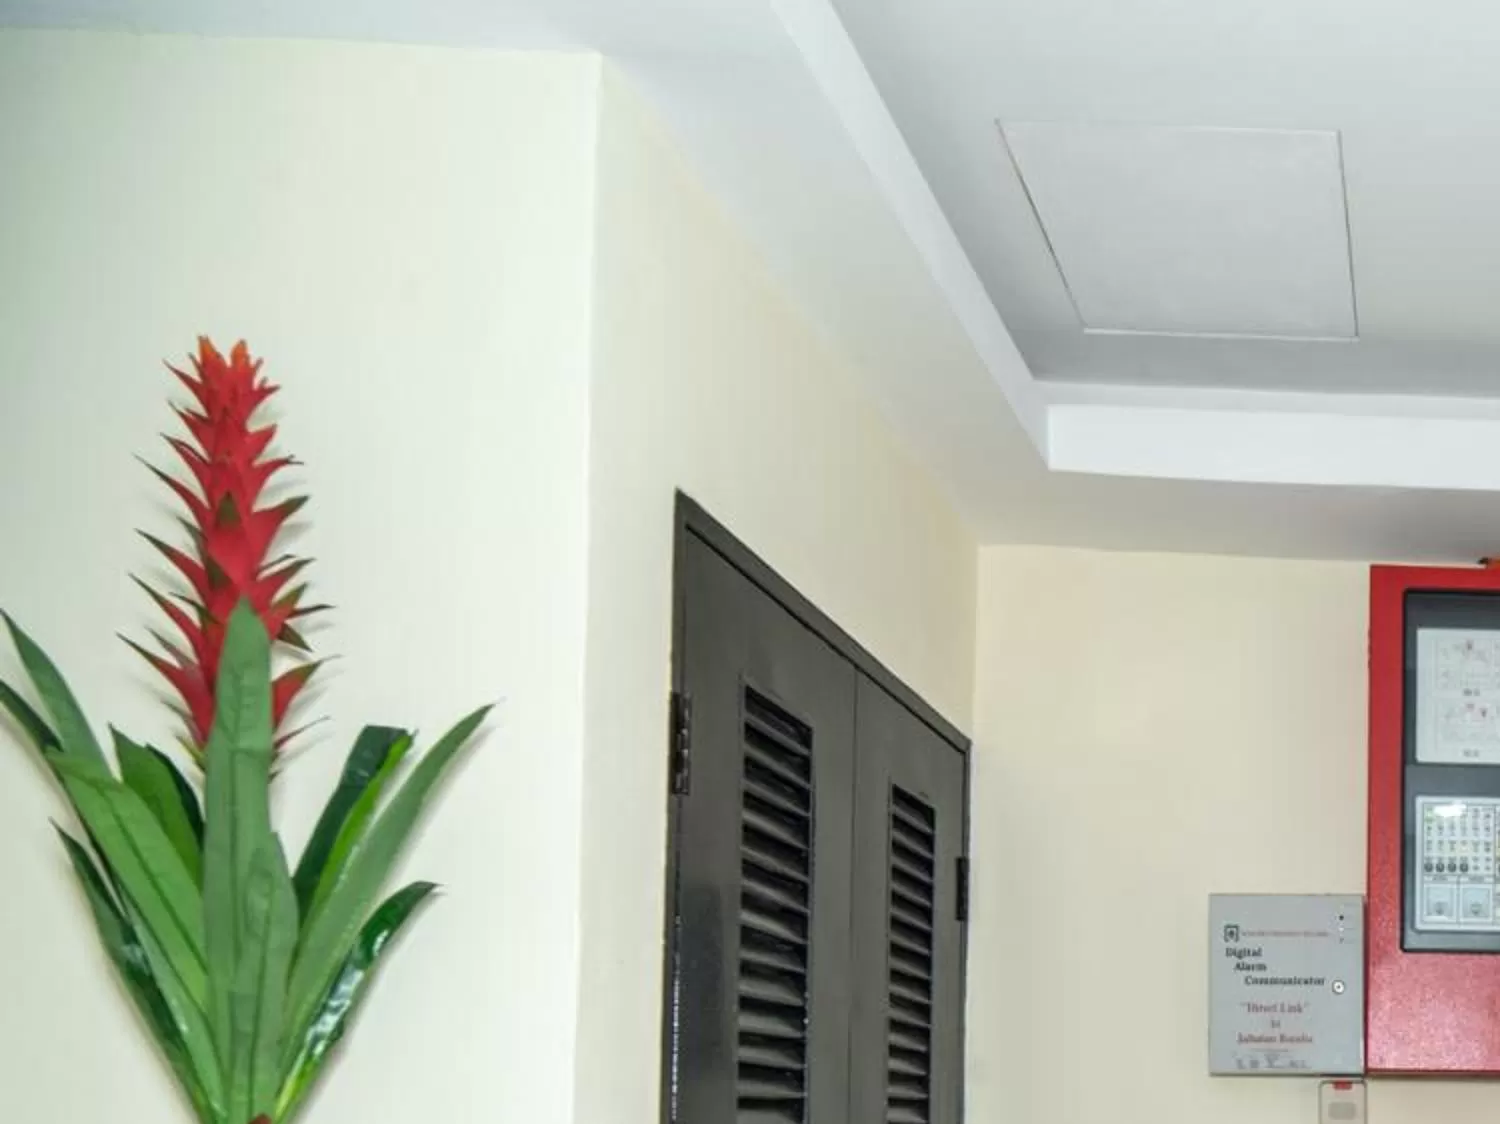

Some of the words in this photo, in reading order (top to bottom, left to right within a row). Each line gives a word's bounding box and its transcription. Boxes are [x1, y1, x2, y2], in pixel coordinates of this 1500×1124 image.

[1225, 947, 1263, 960] Digital
[1233, 962, 1267, 972] Alarm
[1244, 975, 1325, 987] Communicator
